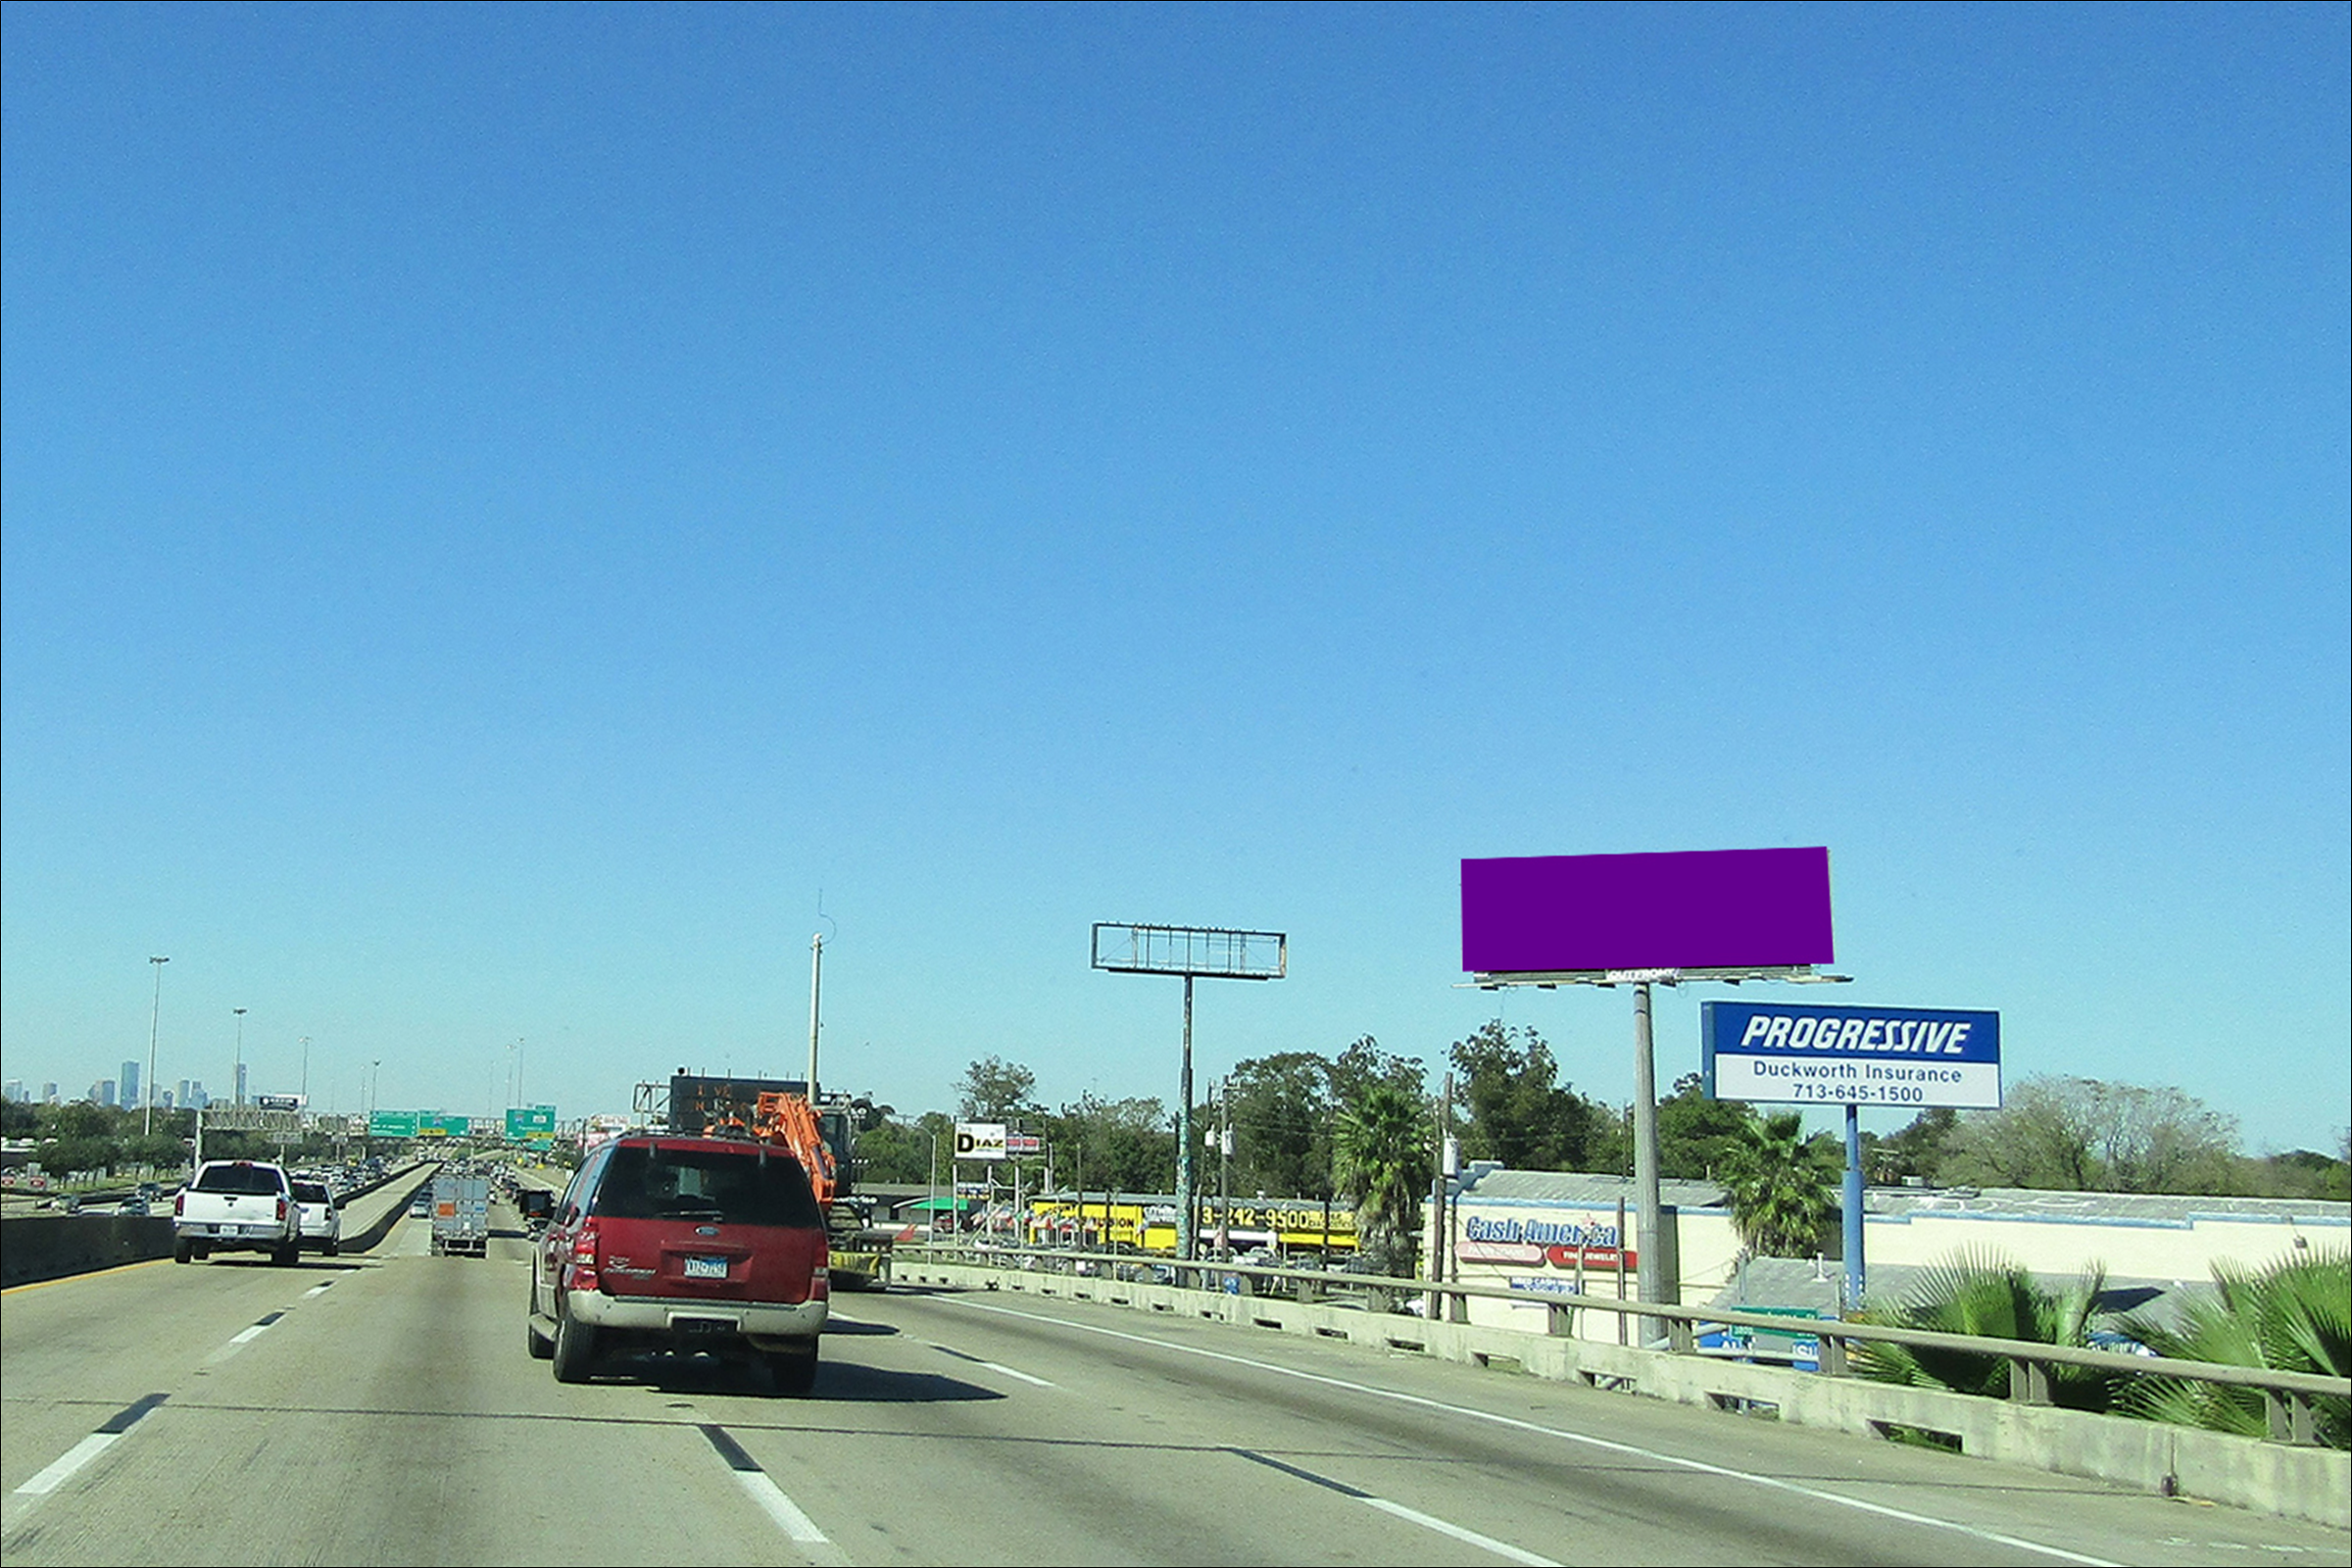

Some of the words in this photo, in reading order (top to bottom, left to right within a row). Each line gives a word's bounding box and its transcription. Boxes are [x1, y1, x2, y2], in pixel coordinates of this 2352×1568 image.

[1740, 1015, 1971, 1054] PROGRESSIVE
[1753, 1060, 1857, 1079] Duckworth
[1865, 1063, 1962, 1083] Insurance
[1792, 1084, 1923, 1102] 713-645-1500
[957, 1134, 1004, 1152] DIAZ
[1466, 1215, 1518, 1243] Cash
